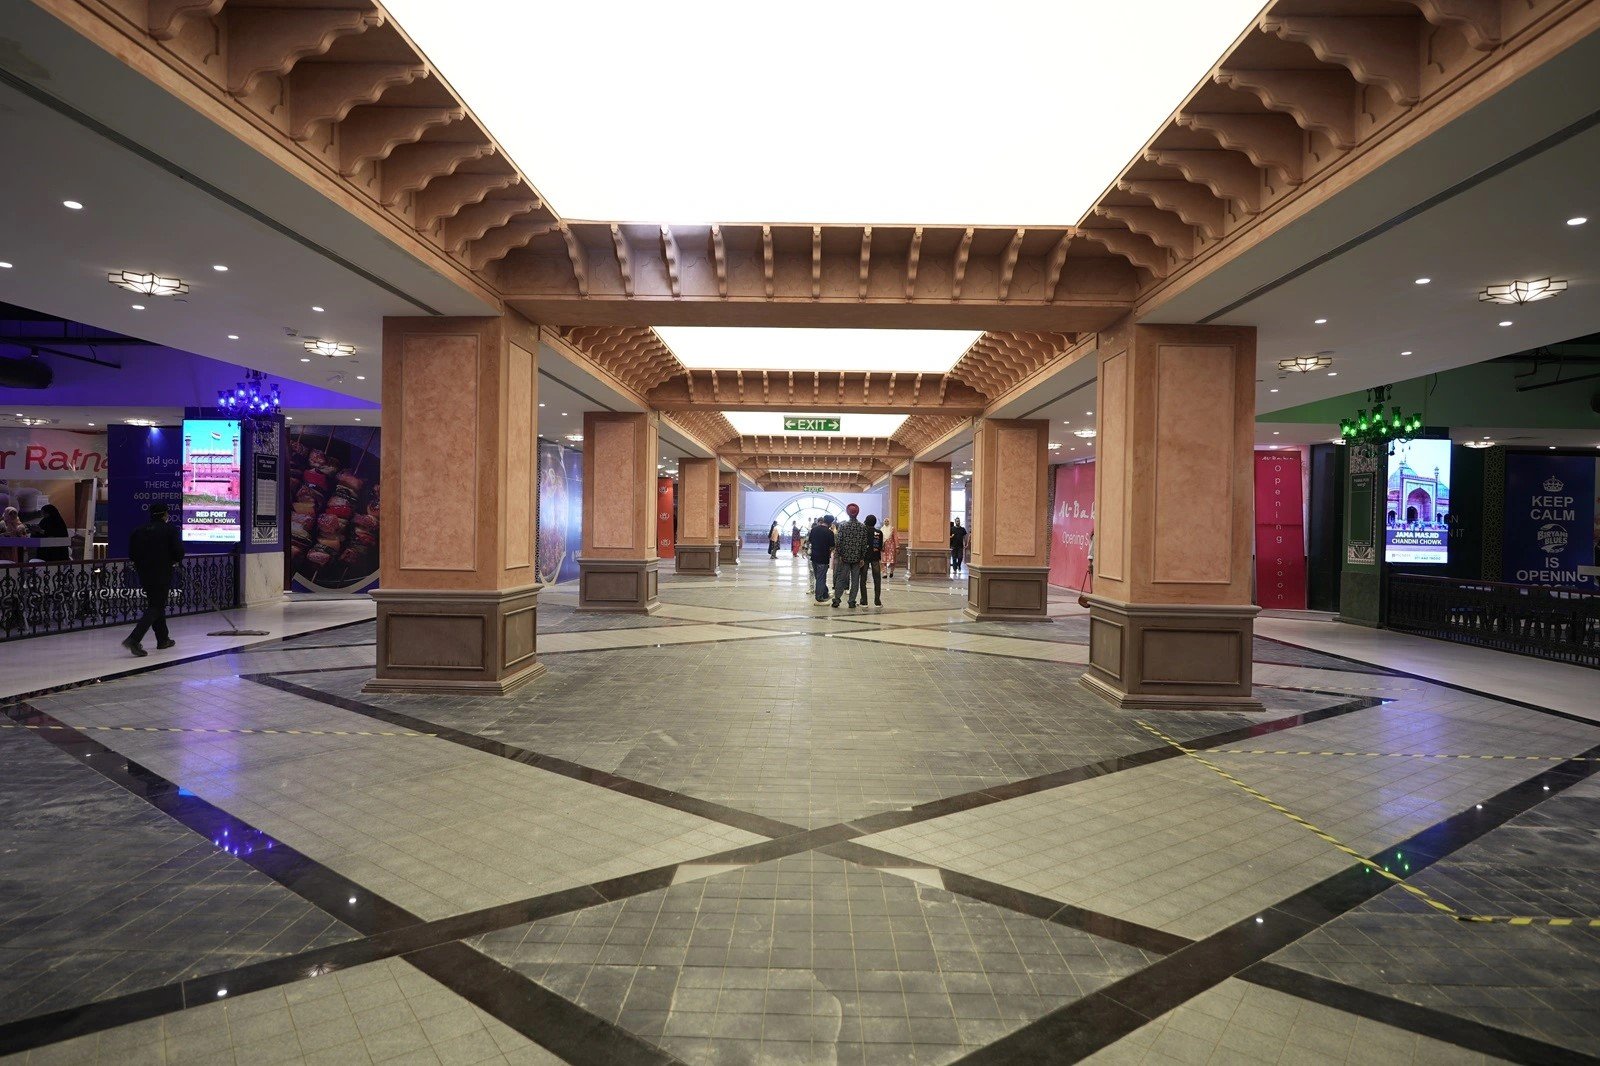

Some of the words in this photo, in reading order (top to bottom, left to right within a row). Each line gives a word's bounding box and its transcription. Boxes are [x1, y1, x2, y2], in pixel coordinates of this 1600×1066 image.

[797, 419, 827, 430] EXIT
[146, 456, 160, 465] Did
[162, 457, 179, 468] you
[144, 480, 170, 488] THERE
[133, 492, 151, 500] 600
[1531, 495, 1574, 508] KEEP
[1530, 508, 1575, 521] CALM
[1544, 537, 1568, 545] BLUES
[1544, 557, 1560, 569] IS
[1516, 570, 1588, 582] OPENING
